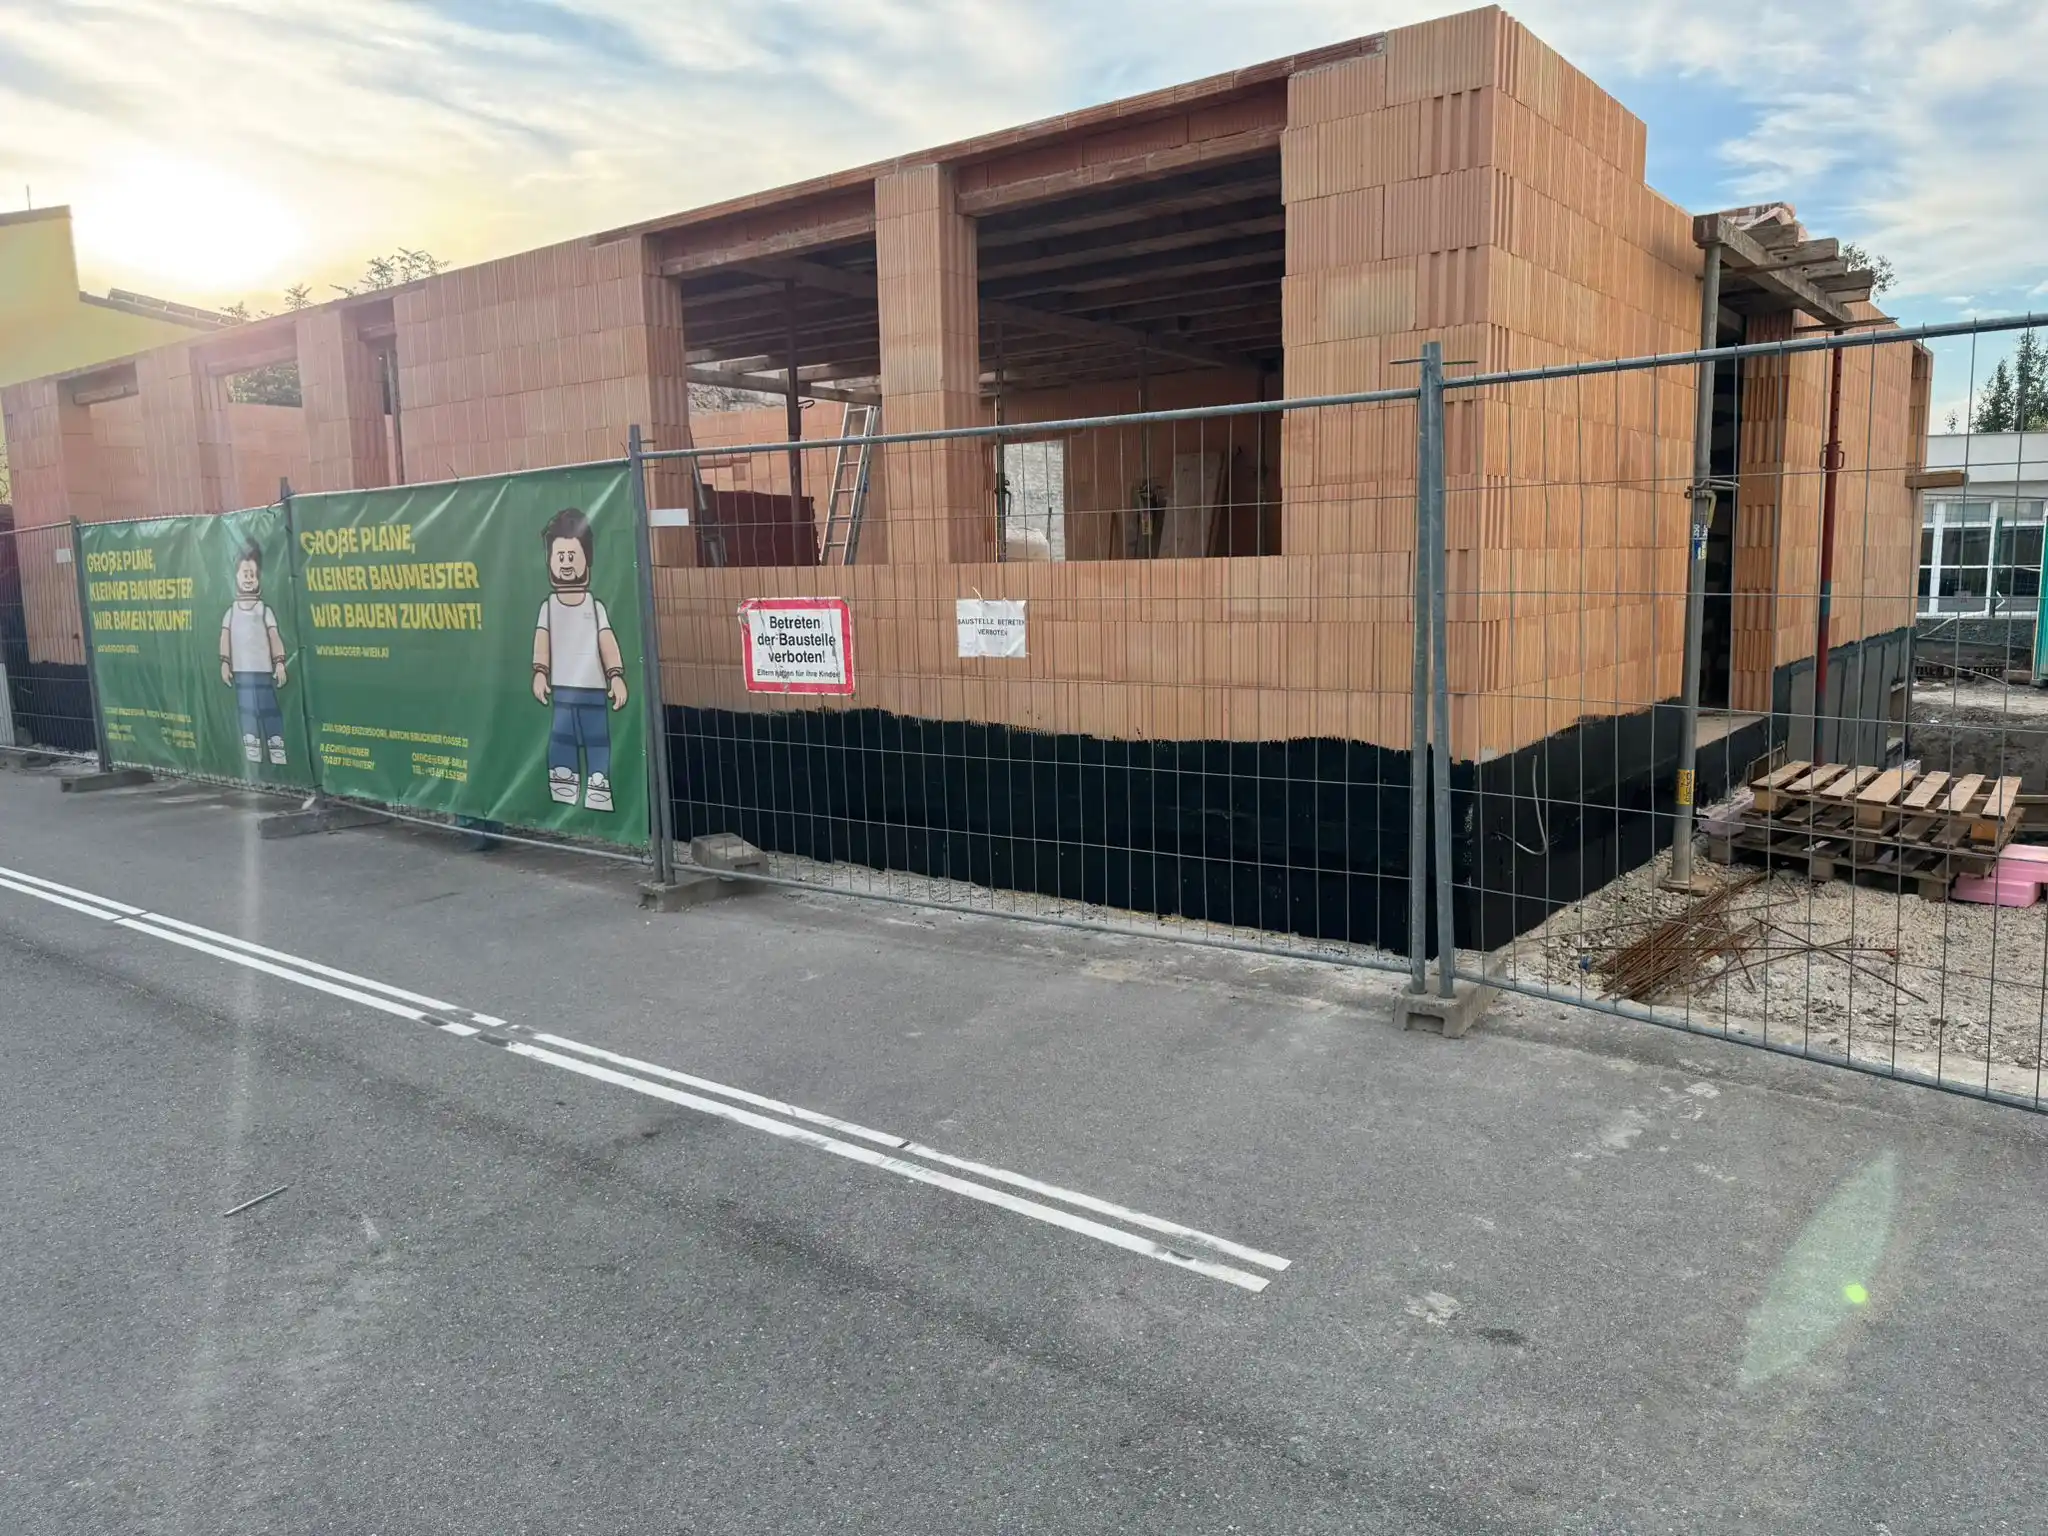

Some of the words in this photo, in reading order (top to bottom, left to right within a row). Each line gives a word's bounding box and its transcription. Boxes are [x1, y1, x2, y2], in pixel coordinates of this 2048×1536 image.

[360, 521, 416, 554] PLÄNE,
[306, 566, 368, 591] KLEINER
[368, 562, 480, 590] BAUMEISTER
[94, 610, 113, 630] WIR
[311, 603, 342, 627] WIR
[344, 603, 398, 628] BAUEN
[399, 603, 482, 630] ZUKUNFT!
[769, 616, 820, 629] Betreten
[757, 633, 775, 646] der
[779, 633, 836, 646] Baustelle
[768, 650, 826, 663] verboten!
[796, 669, 804, 677] für
